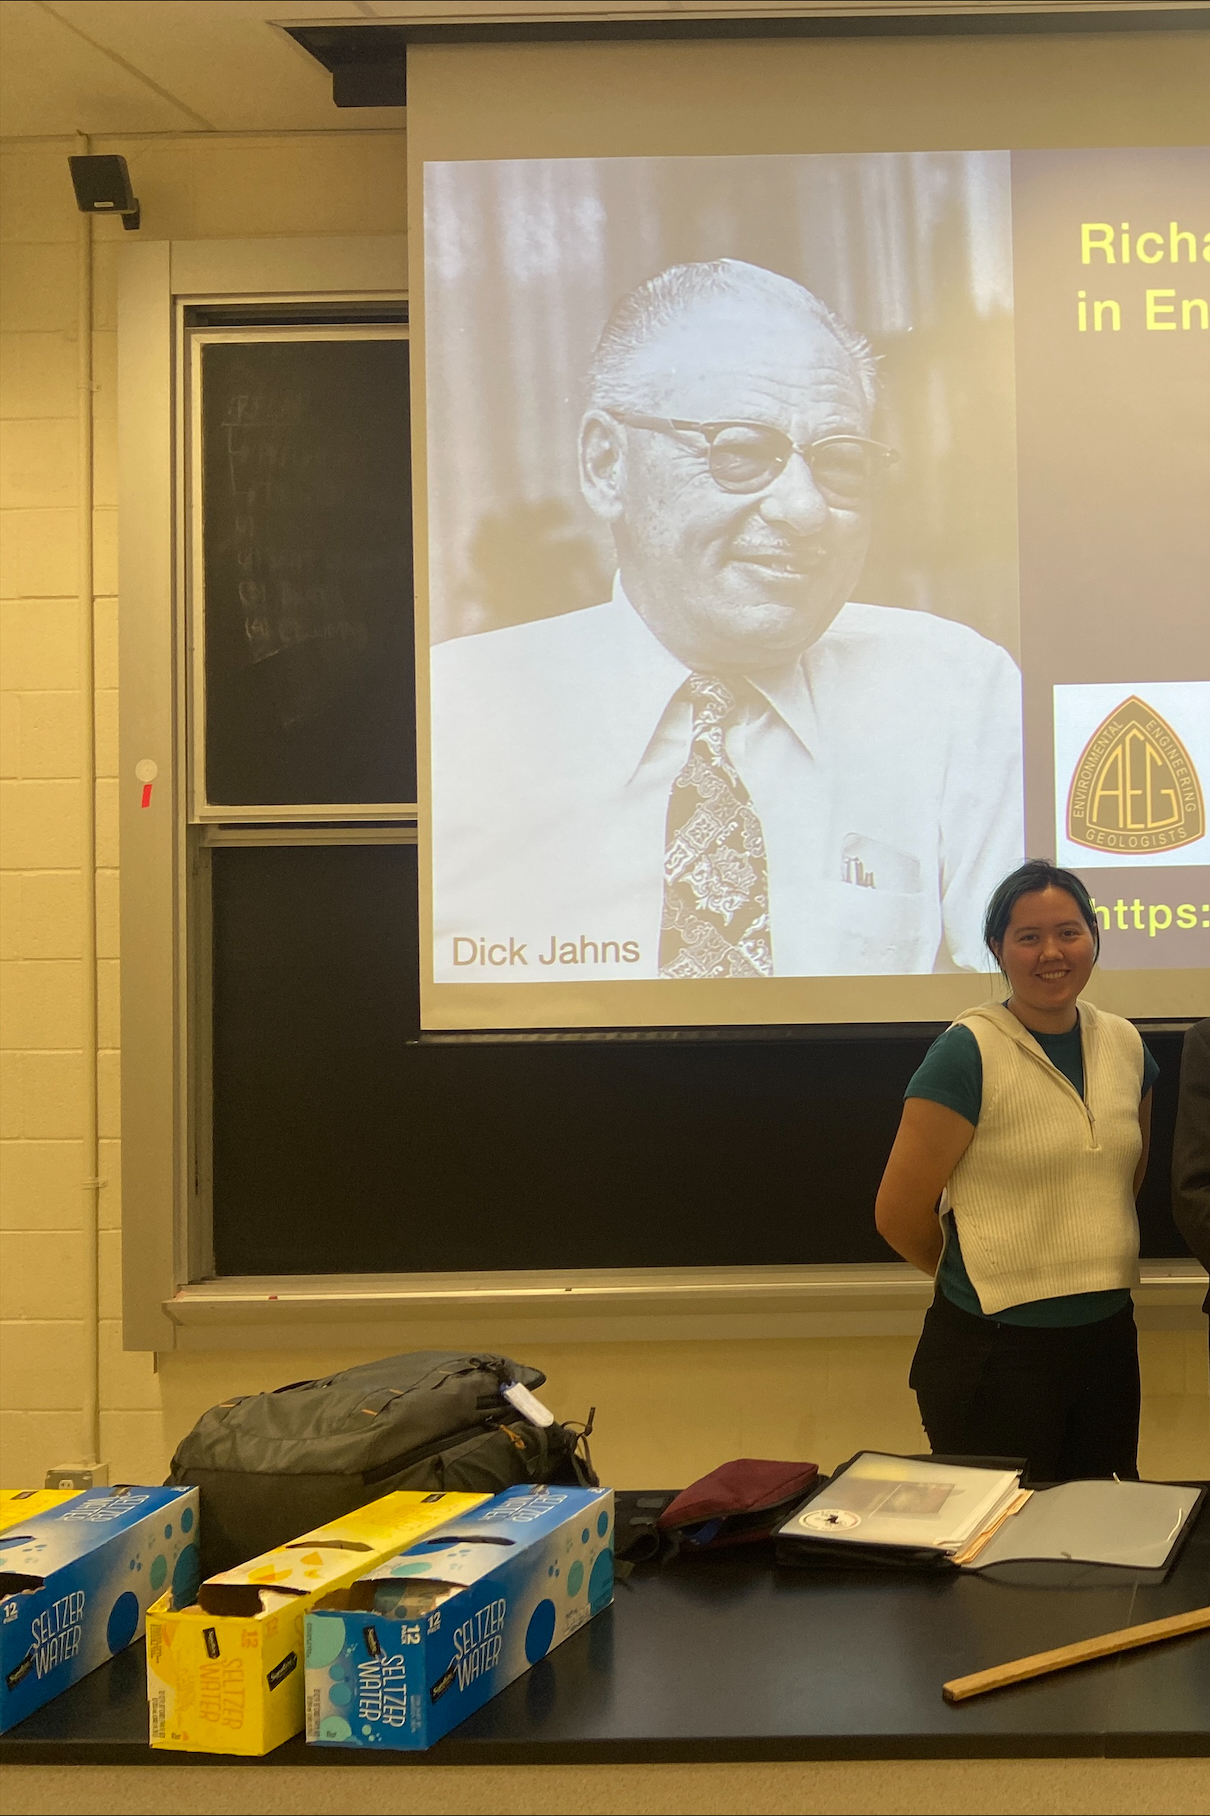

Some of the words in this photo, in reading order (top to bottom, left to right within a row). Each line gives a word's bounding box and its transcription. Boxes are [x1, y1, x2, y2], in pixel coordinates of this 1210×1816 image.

[1077, 290, 1122, 332] in
[1073, 720, 1124, 818] ENVIRONMENTAL
[1092, 727, 1179, 830] AEG
[1145, 719, 1197, 813] ENGINEERING
[1085, 826, 1187, 848] GEOLOGISTS
[452, 936, 528, 966] Dick
[538, 934, 641, 965] Jahns
[3, 1602, 18, 1617] 12
[31, 1590, 85, 1648] SELTZER
[408, 1625, 421, 1645] 12
[428, 1611, 441, 1628] 12
[453, 1598, 507, 1660] SELTZER
[35, 1625, 82, 1680] WATER
[456, 1635, 502, 1692] WATER
[199, 1662, 222, 1722] WATER
[220, 1658, 246, 1730] SELTZER
[357, 1659, 381, 1722] WATER
[381, 1654, 407, 1728] SELTZER
